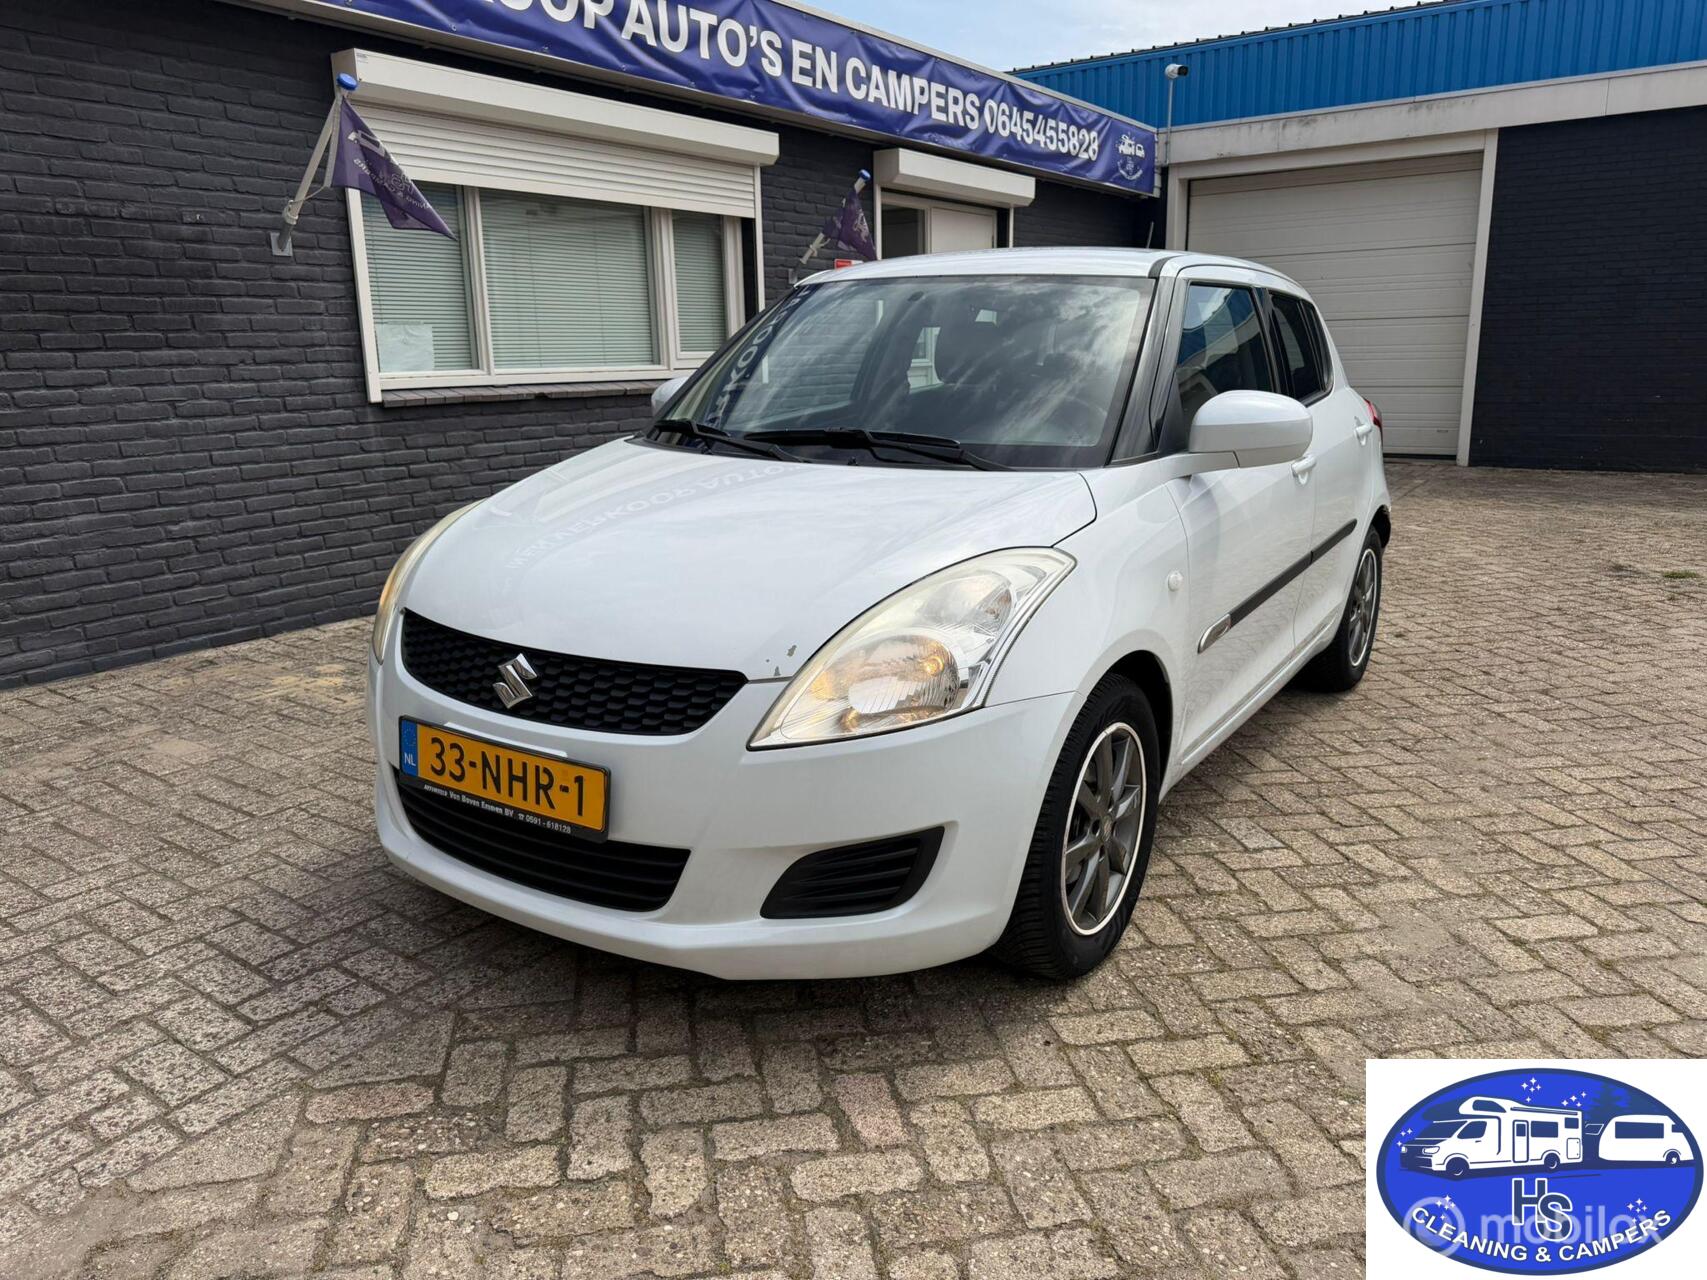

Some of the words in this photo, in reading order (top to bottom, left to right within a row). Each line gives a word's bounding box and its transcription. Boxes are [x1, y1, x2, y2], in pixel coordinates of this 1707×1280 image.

[621, 0, 783, 78] AUTO'S
[791, 38, 838, 94] EN
[845, 57, 980, 131] CAMPERS
[983, 98, 1099, 162] 0645455828
[403, 752, 417, 768] NL
[429, 736, 585, 817] 33-NHR-1
